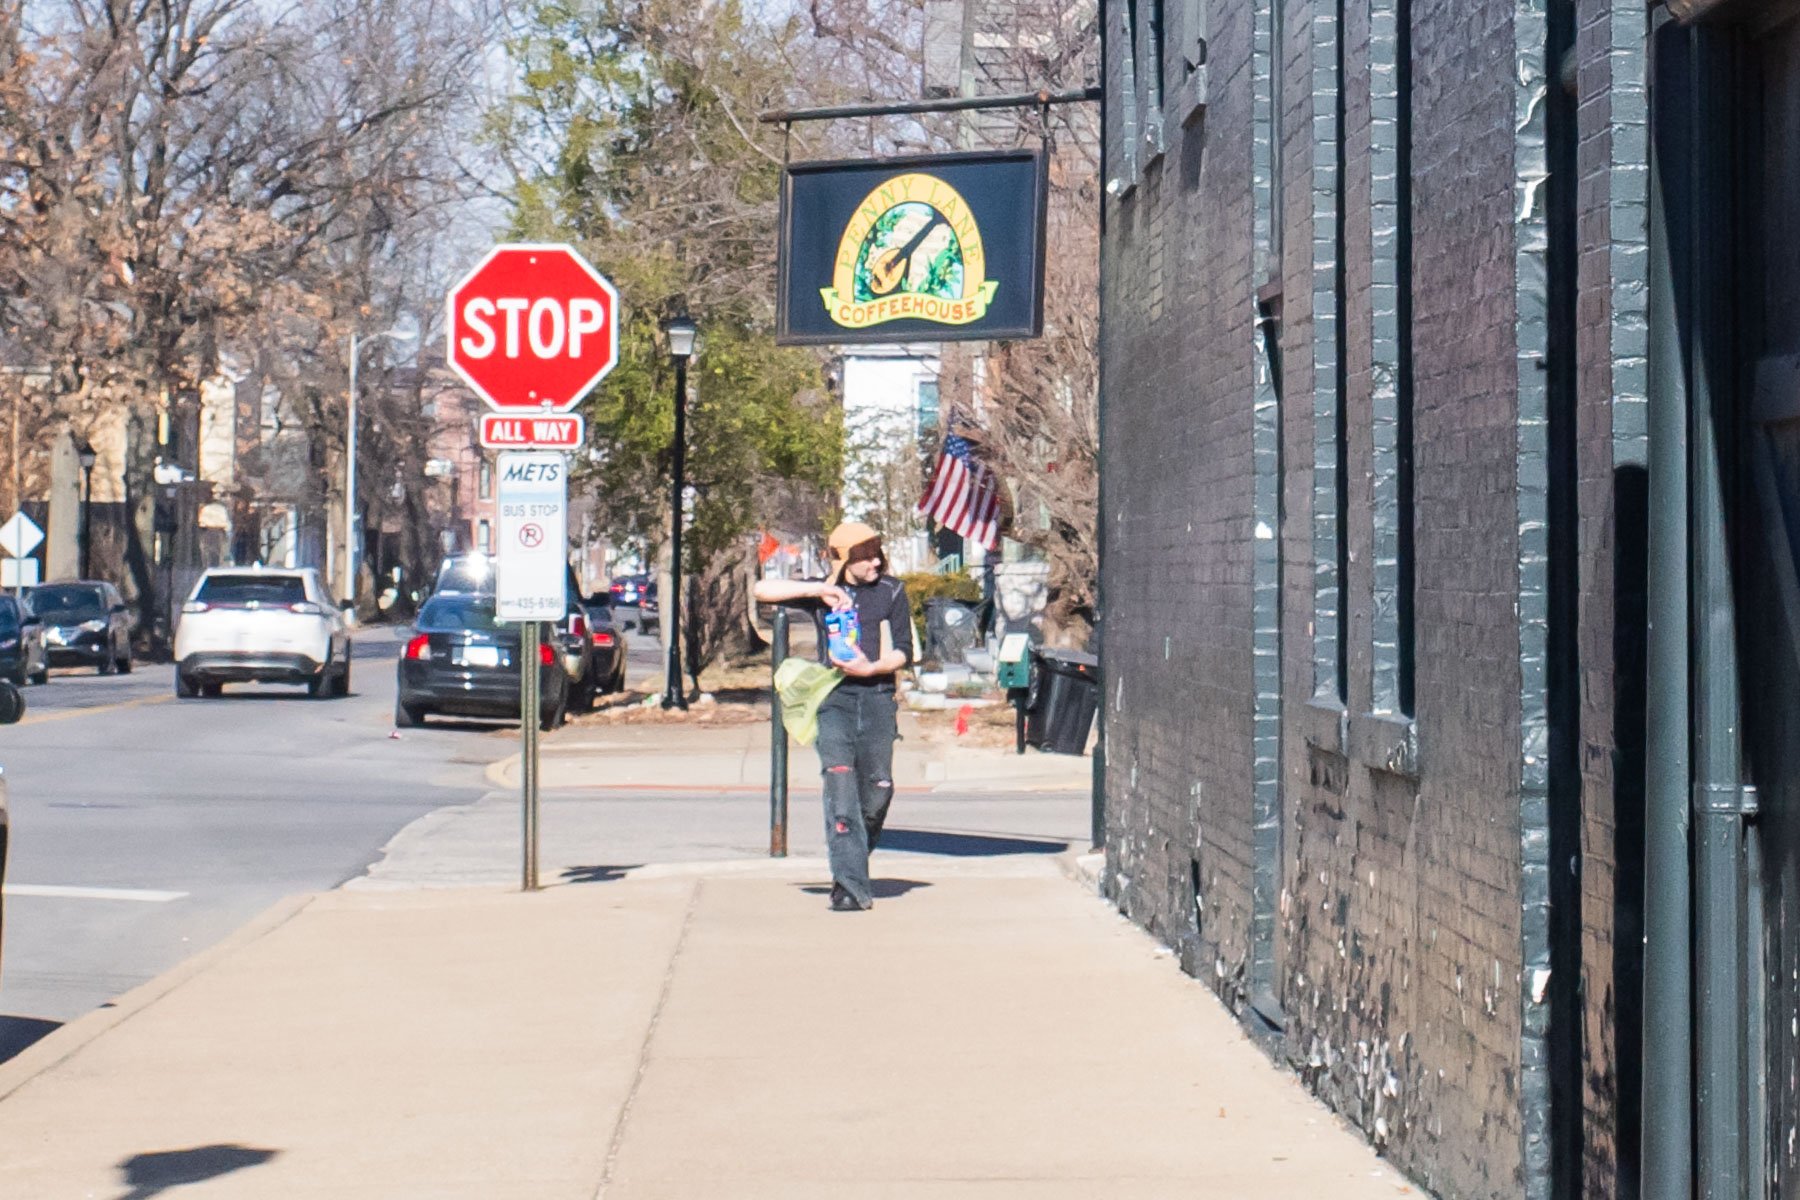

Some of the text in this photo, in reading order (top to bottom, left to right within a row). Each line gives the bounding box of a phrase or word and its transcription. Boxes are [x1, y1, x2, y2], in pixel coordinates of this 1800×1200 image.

[839, 177, 980, 269] PENNY LANE
[839, 296, 977, 323] COFFEEHOUSE
[461, 297, 604, 359] STOP
[491, 421, 571, 442] ALL WAY
[503, 464, 560, 481] METS
[503, 504, 559, 517] BUS STOP
